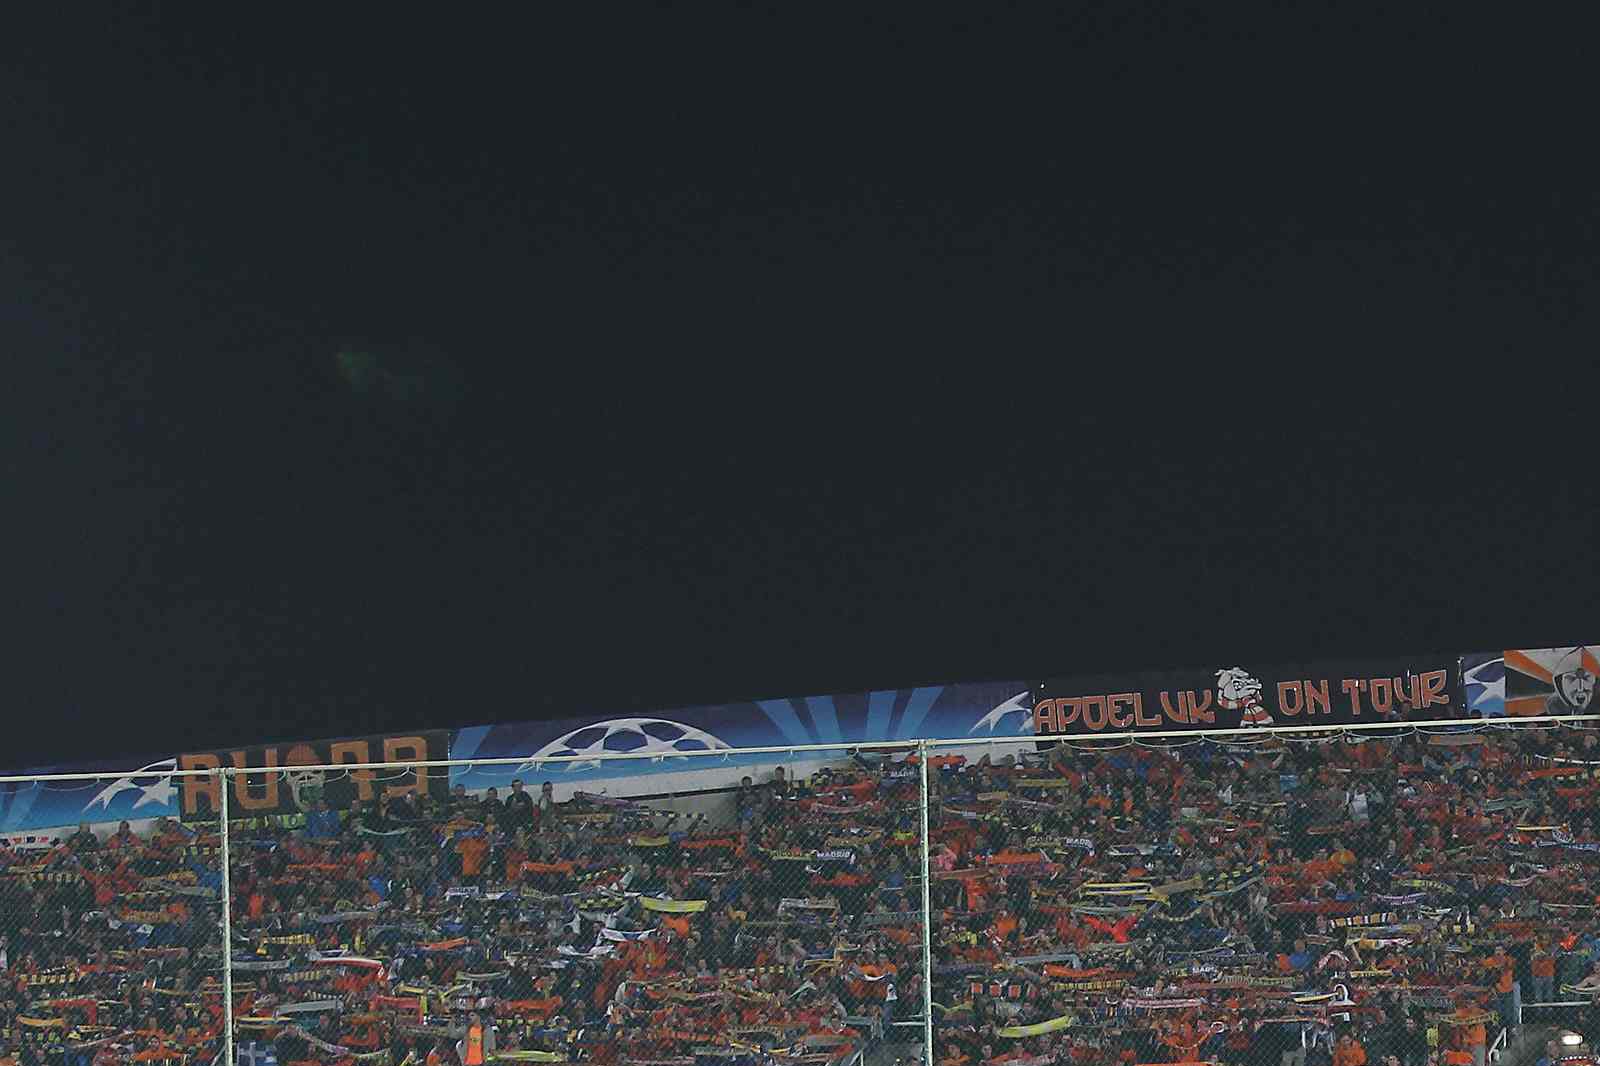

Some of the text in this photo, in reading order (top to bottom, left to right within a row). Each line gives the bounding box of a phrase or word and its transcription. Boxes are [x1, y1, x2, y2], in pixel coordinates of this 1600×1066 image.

[1033, 669, 1447, 733] APOEL UK ON TOUR
